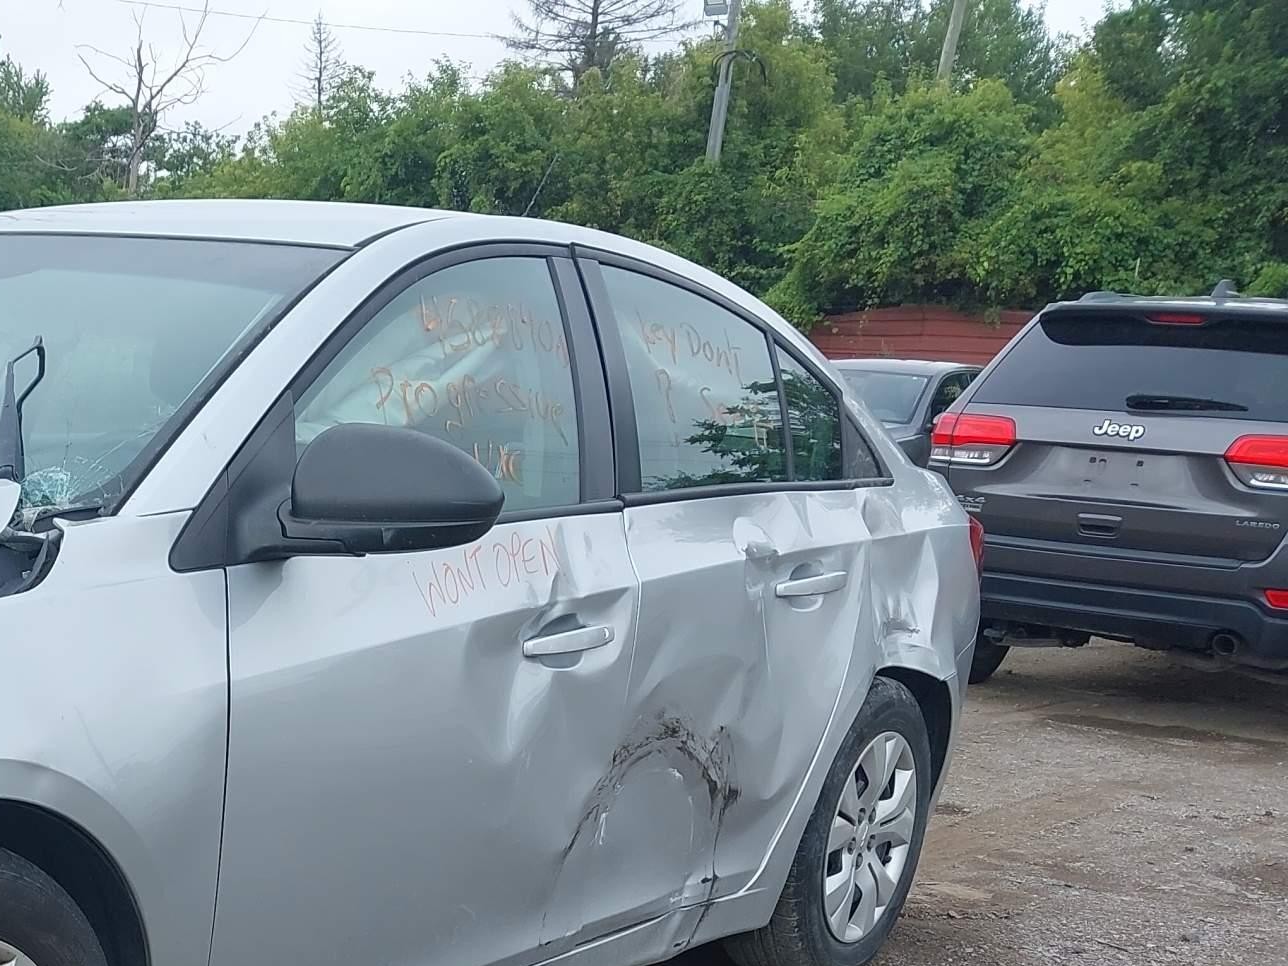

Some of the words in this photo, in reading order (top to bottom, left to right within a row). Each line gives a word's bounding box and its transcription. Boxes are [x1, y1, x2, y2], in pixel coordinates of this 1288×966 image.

[1093, 418, 1145, 441] Jeep
[1235, 519, 1281, 530] LAREDO
[493, 525, 561, 588] OPEN
